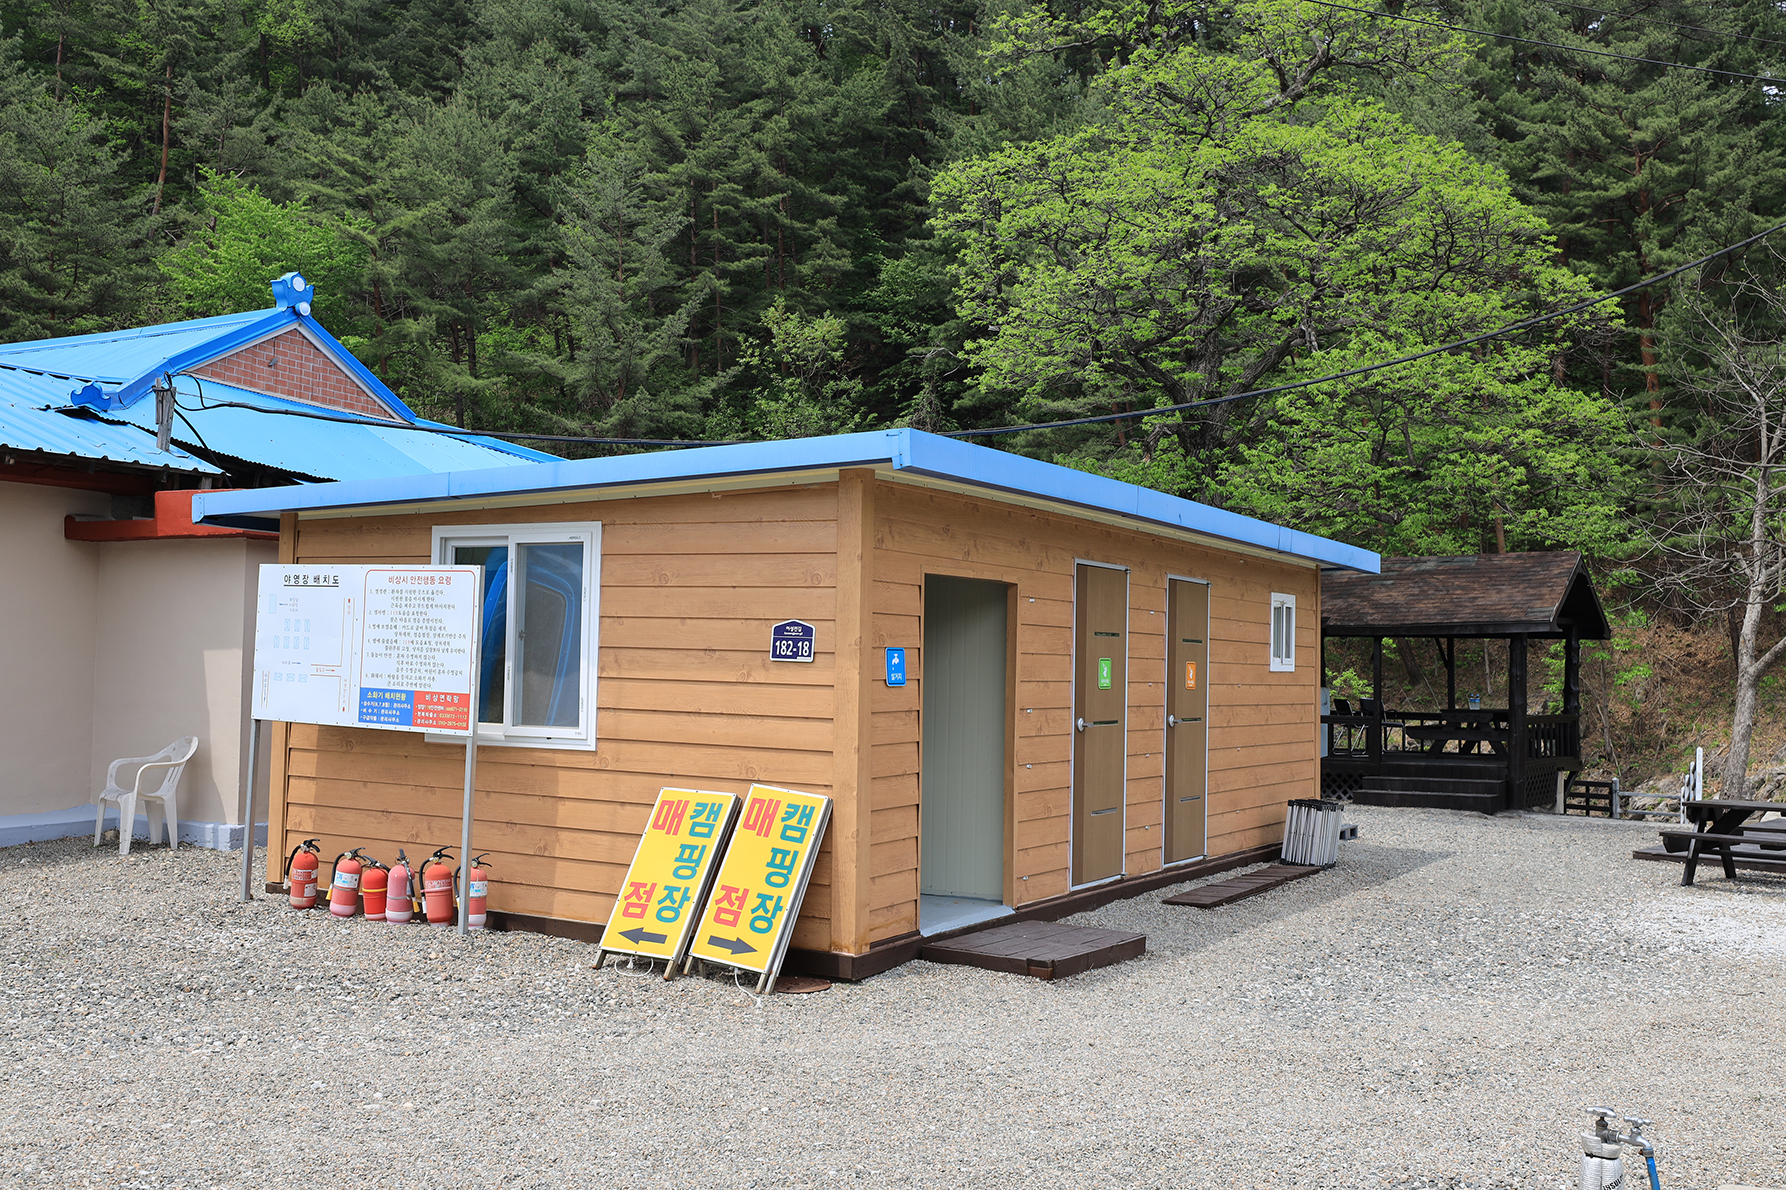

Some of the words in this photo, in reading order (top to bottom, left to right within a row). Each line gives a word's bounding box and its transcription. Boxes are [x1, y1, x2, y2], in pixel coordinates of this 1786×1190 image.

[284, 574, 309, 584] 야영장
[314, 575, 339, 584] 배치도
[389, 576, 408, 585] 비상시
[410, 576, 436, 585] 안전행동
[438, 576, 452, 585] 요령
[775, 640, 809, 656] 182-18
[367, 691, 383, 699] 소화기
[385, 692, 406, 701] 배치현황
[425, 694, 459, 703] 비상연락망
[655, 802, 723, 923] 캠핑장
[749, 803, 815, 934] 캠핑장
